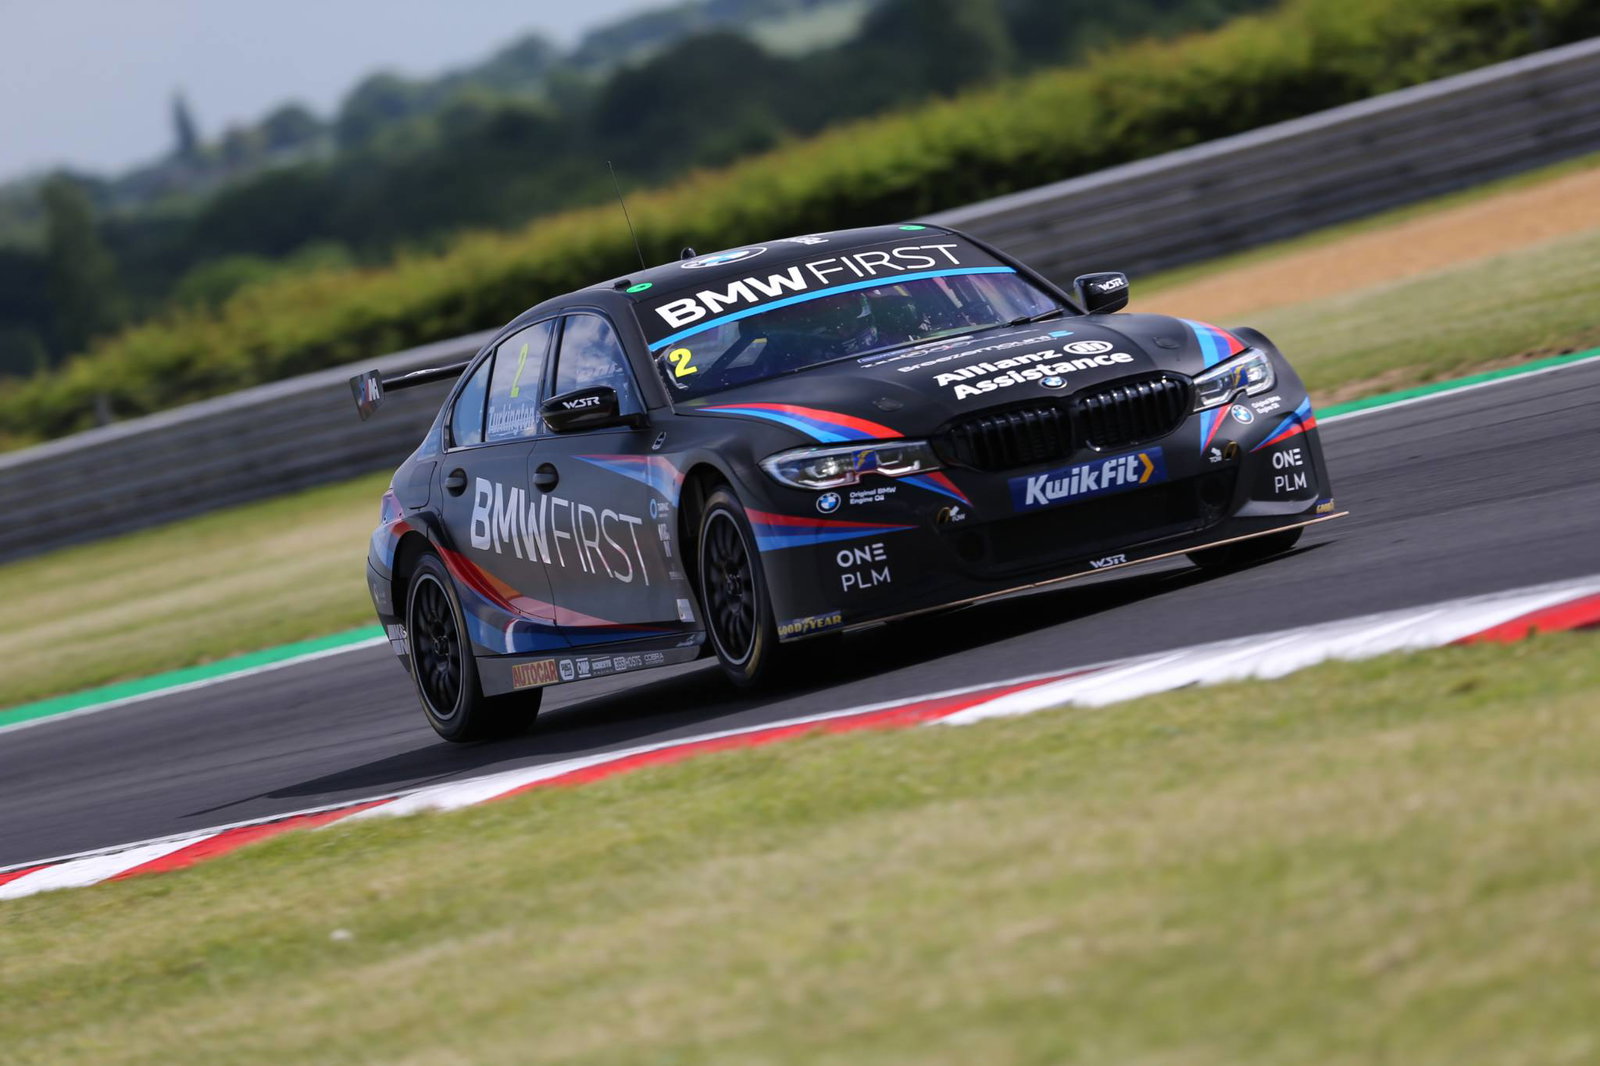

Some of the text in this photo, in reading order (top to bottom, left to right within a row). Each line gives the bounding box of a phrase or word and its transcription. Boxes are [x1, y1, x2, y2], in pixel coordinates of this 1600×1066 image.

[510, 343, 529, 398] 2
[668, 347, 698, 378] 2
[933, 348, 1064, 387] Allianz
[953, 350, 1135, 401] Assistance
[562, 396, 600, 410] WSR
[1272, 447, 1303, 470] ONE
[849, 488, 876, 499] Original
[877, 486, 896, 495] BMW
[1274, 471, 1307, 494] PLM
[849, 496, 873, 506] Engine
[874, 494, 885, 503] Oil
[836, 542, 887, 568] ONE
[1089, 553, 1126, 569] WSR
[841, 567, 891, 592] PLM
[512, 660, 558, 688] AUTOCAR
